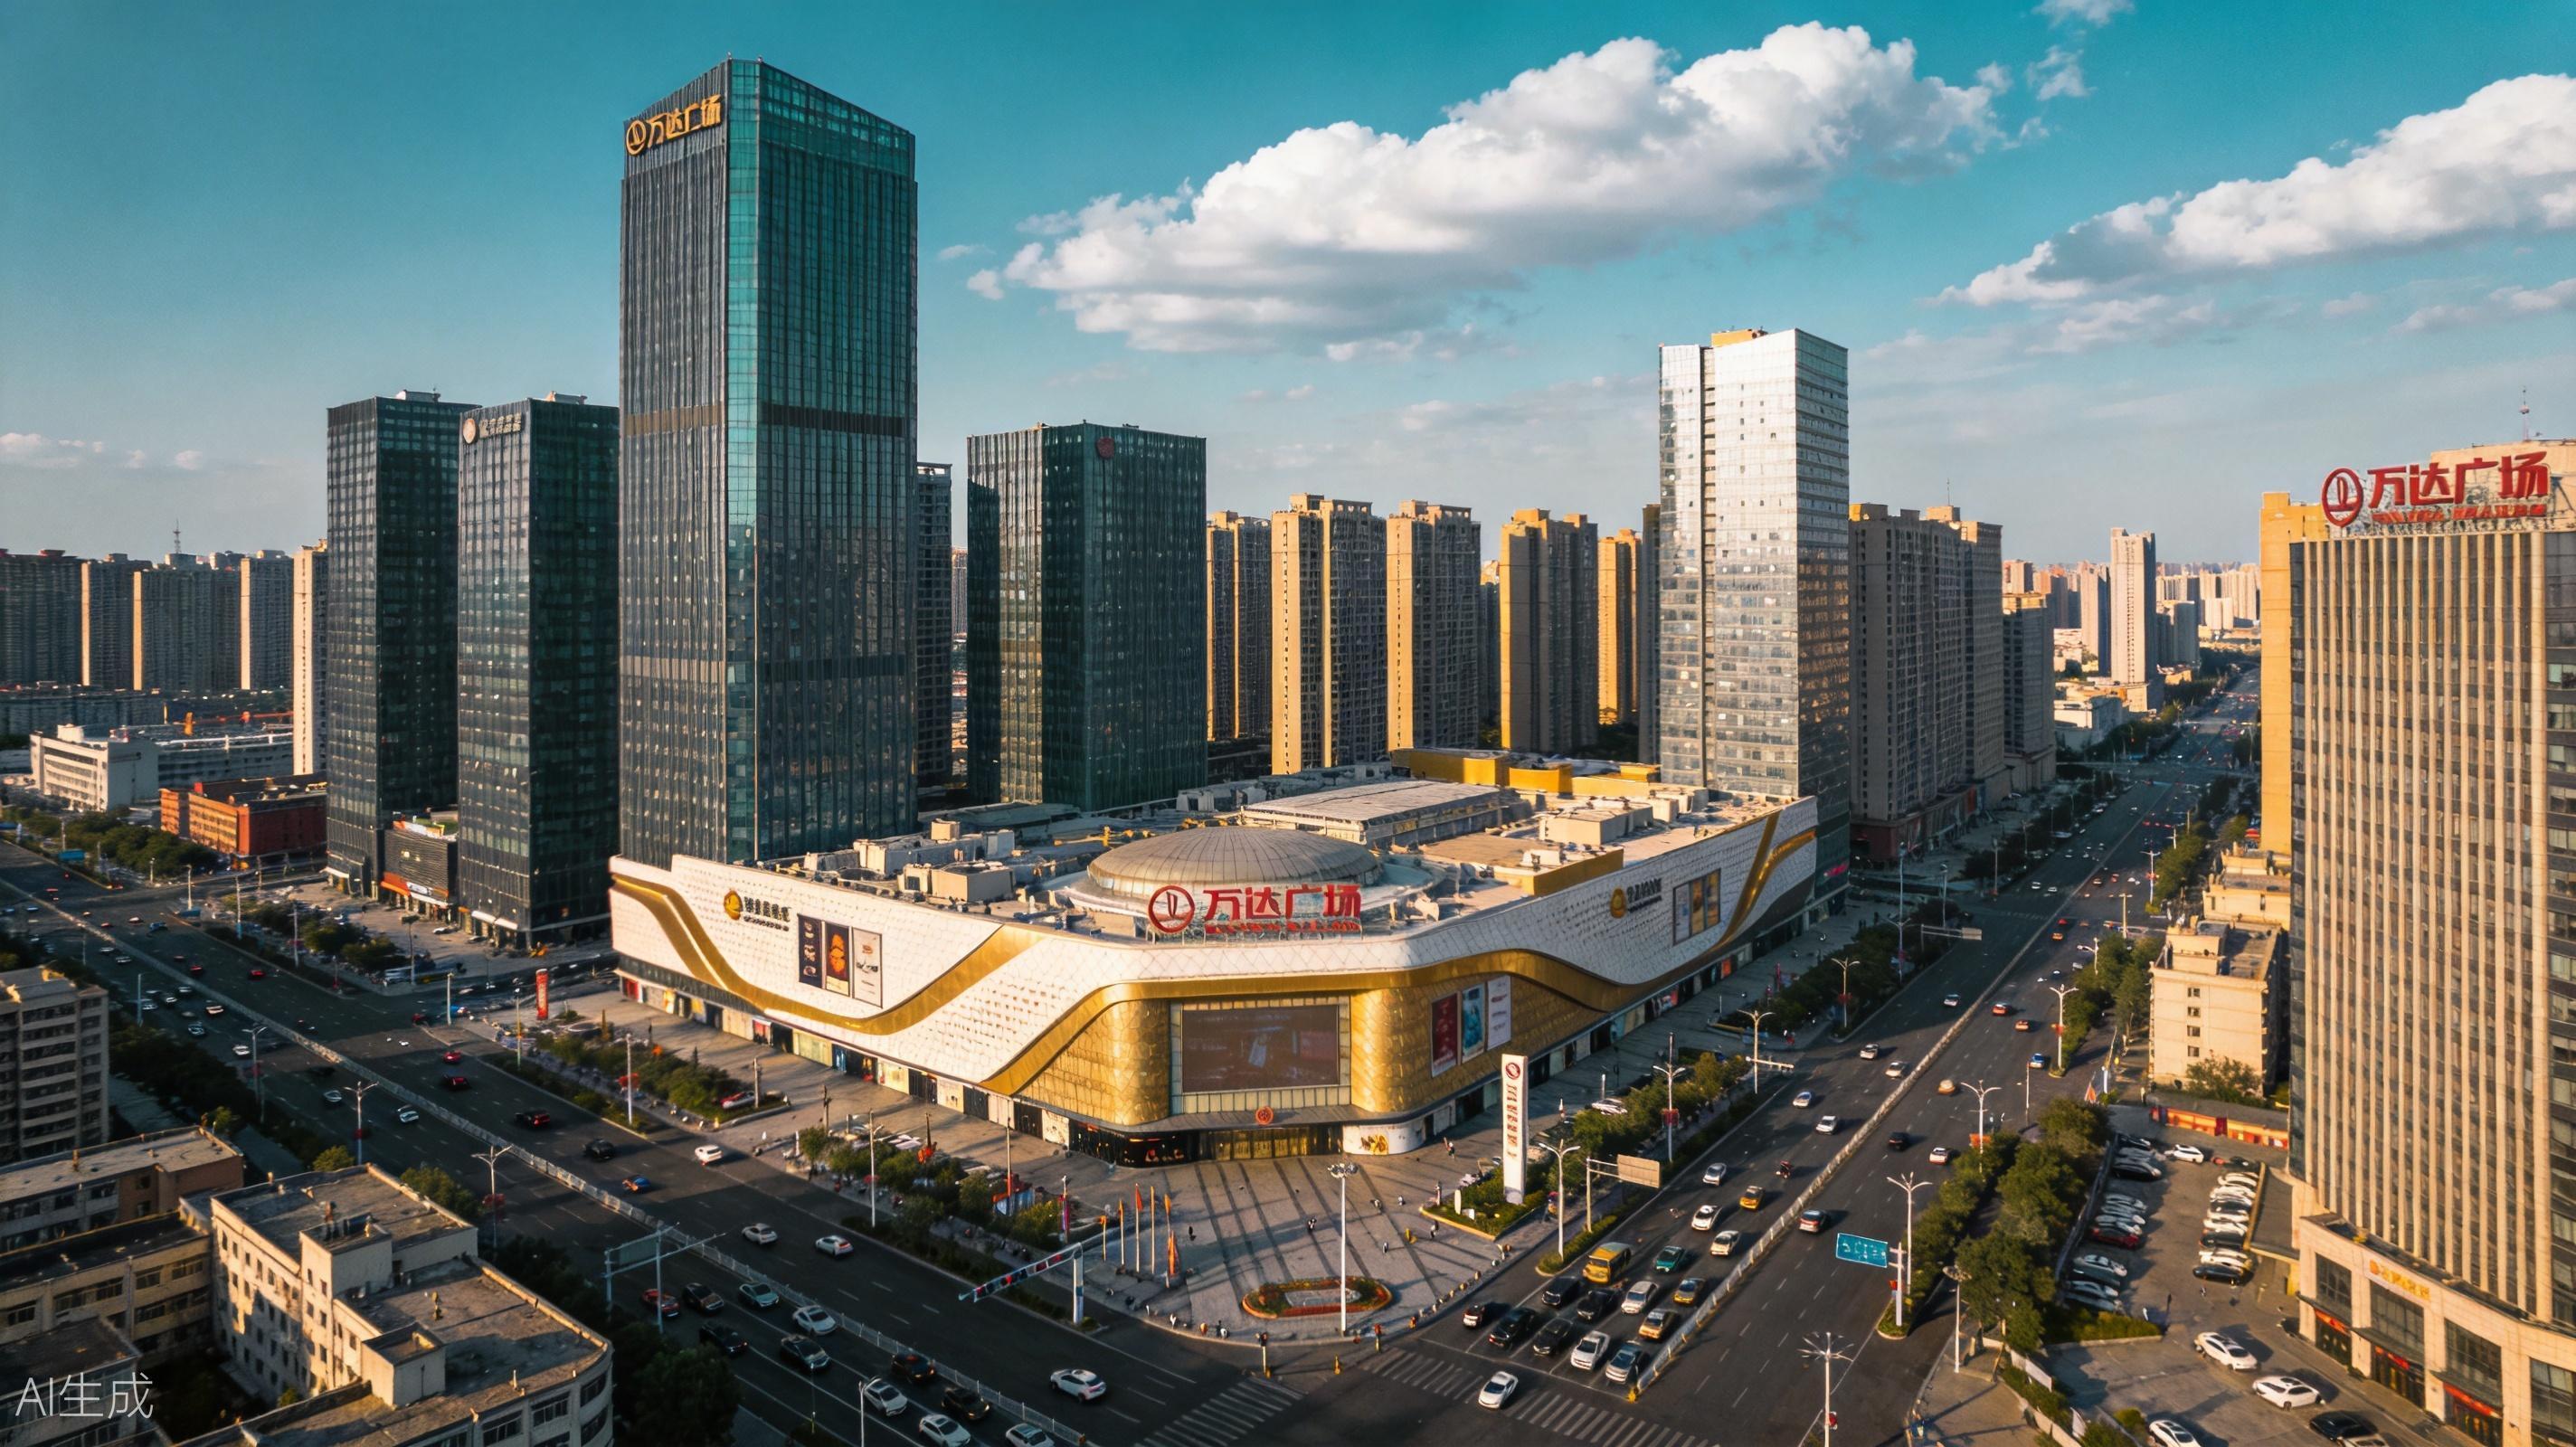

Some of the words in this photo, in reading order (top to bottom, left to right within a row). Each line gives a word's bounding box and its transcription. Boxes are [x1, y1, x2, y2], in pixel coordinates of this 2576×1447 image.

[646, 94, 721, 148] 万达广场
[2367, 450, 2551, 508] 万达广场
[1203, 884, 1362, 922] 万达广场
